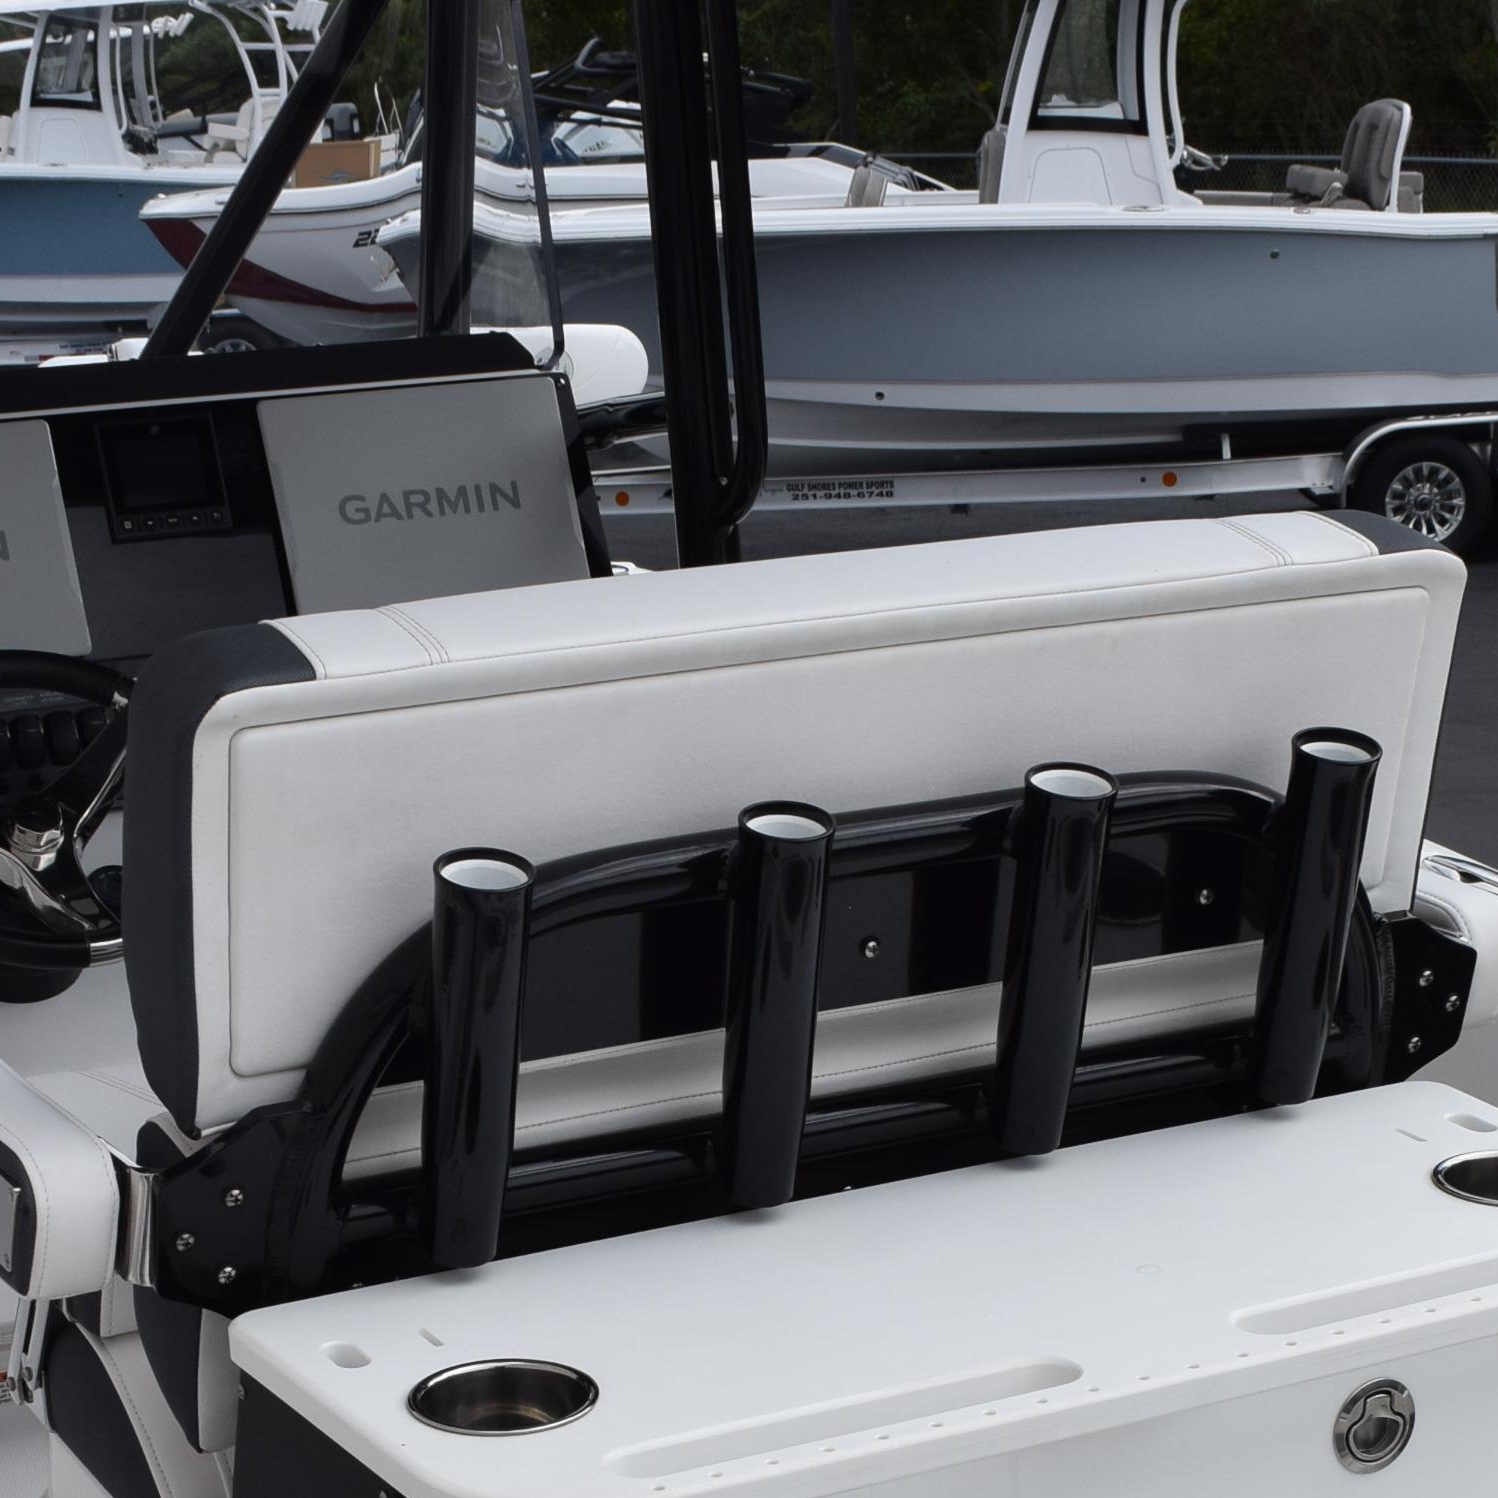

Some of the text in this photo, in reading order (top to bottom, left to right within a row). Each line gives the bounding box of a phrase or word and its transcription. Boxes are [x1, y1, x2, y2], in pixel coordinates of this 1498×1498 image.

[786, 480, 894, 493] GULF SHORES POWER SPORTS
[340, 480, 521, 525] GARMIN
